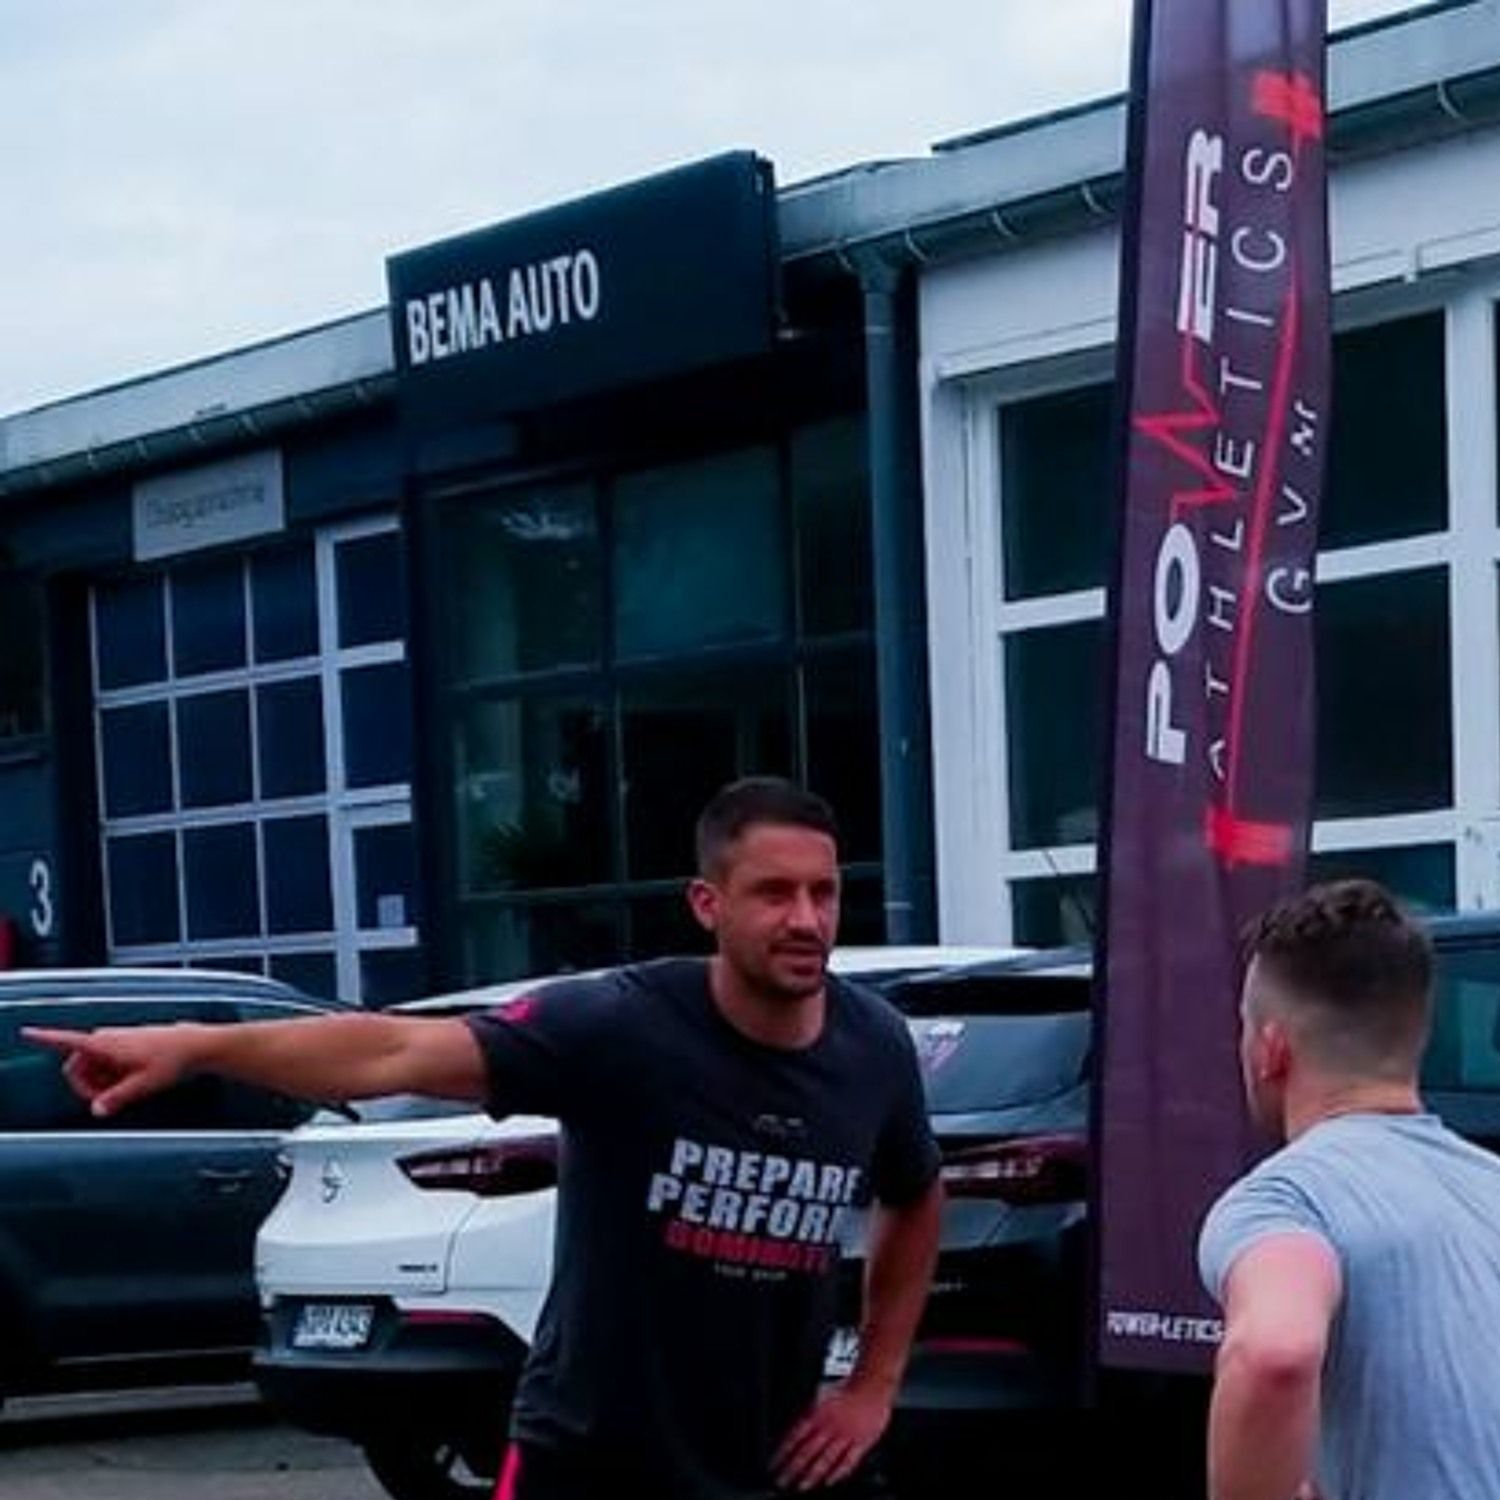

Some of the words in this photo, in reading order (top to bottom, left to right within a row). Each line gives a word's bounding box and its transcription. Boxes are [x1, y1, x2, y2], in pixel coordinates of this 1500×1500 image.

[406, 278, 504, 367] BEMA
[507, 249, 600, 339] AUTO
[1133, 128, 1237, 765] POWER
[1205, 145, 1294, 782] ATHLETICS
[29, 860, 52, 937] 3
